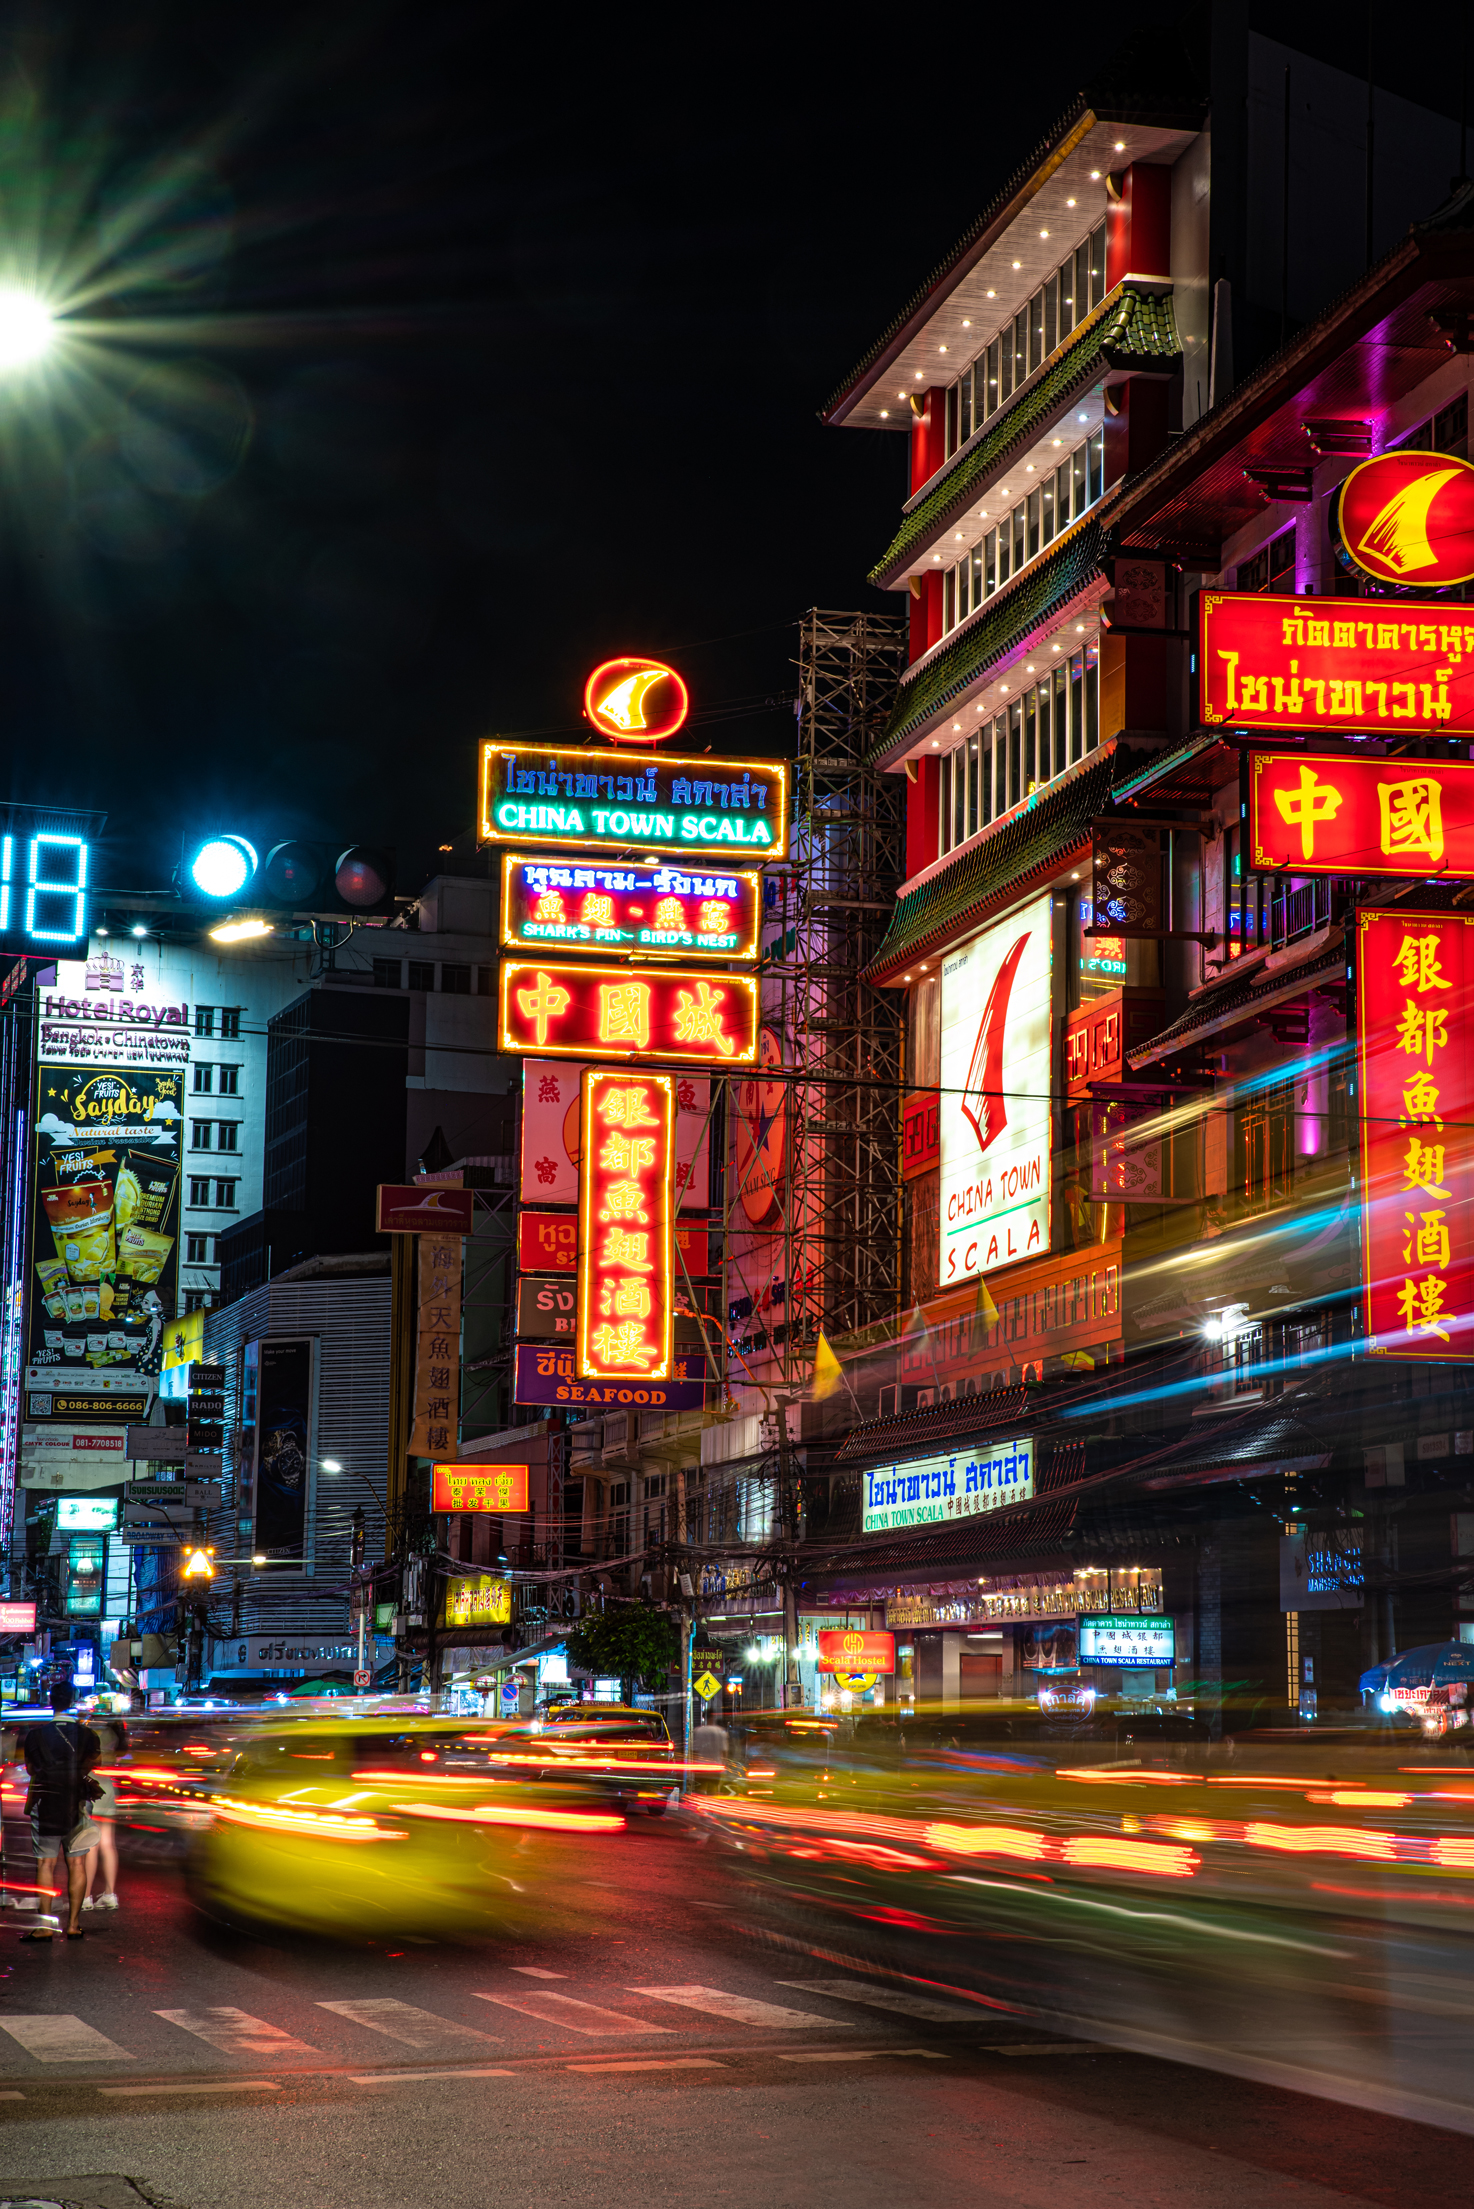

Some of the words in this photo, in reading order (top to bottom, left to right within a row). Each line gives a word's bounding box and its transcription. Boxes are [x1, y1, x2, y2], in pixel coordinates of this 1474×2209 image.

[1217, 649, 1453, 719] ไชน่าทาวน์
[501, 753, 658, 803] ไชน่าทาวน์
[671, 772, 767, 809] สกาล่า
[499, 803, 584, 831] CHINA
[592, 811, 675, 837] TOWN
[682, 817, 772, 844] SCALA
[1274, 765, 1445, 862] 中國
[523, 922, 591, 940] SHARK'S
[641, 929, 693, 946] BIRD'S
[697, 934, 737, 949] NEST
[46, 995, 114, 1020] Hotel
[119, 999, 188, 1028] Royal
[516, 971, 734, 1055] 中國城
[41, 1024, 103, 1047] Bangkok
[112, 1030, 191, 1051] Chinatown
[94, 1089, 120, 1099] FRUITS
[69, 1126, 121, 1137] Natural
[124, 1126, 154, 1135] taste
[1392, 934, 1457, 1343] 銀都魚翅酒樓
[60, 1159, 94, 1175] FRUITS
[61, 1151, 84, 1161] YES!
[948, 1178, 993, 1221] CHINA
[1000, 1155, 1040, 1201] TOWN
[593, 1086, 660, 1368] 銀都魚翅酒樓
[947, 1219, 1040, 1279] SCALA
[32, 1353, 61, 1365] FRUITS
[36, 1348, 54, 1358] YES!
[192, 1373, 222, 1381] CITIZEN
[69, 1401, 143, 1410] 086-806-6666
[556, 1385, 668, 1405] SEAFOOD
[75, 1439, 122, 1448] 081-7708518
[866, 1457, 957, 1508] ไชน่าทาวน์
[965, 1441, 1029, 1493] สกาล่า
[865, 1511, 889, 1530] CHINA
[891, 1507, 915, 1526] TOWN
[916, 1503, 944, 1523] SCALA
[1064, 1590, 1086, 1611] TOWN
[1086, 1588, 1109, 1610] SCALA
[1111, 1584, 1159, 1609] RESTAUANT
[1083, 1618, 1112, 1627] ภัตตาคาร
[1113, 1617, 1148, 1628] ไชน่าทาวน์
[1150, 1620, 1171, 1629] สกาล่า
[822, 1655, 851, 1665] Scala
[853, 1655, 886, 1665] Hostel
